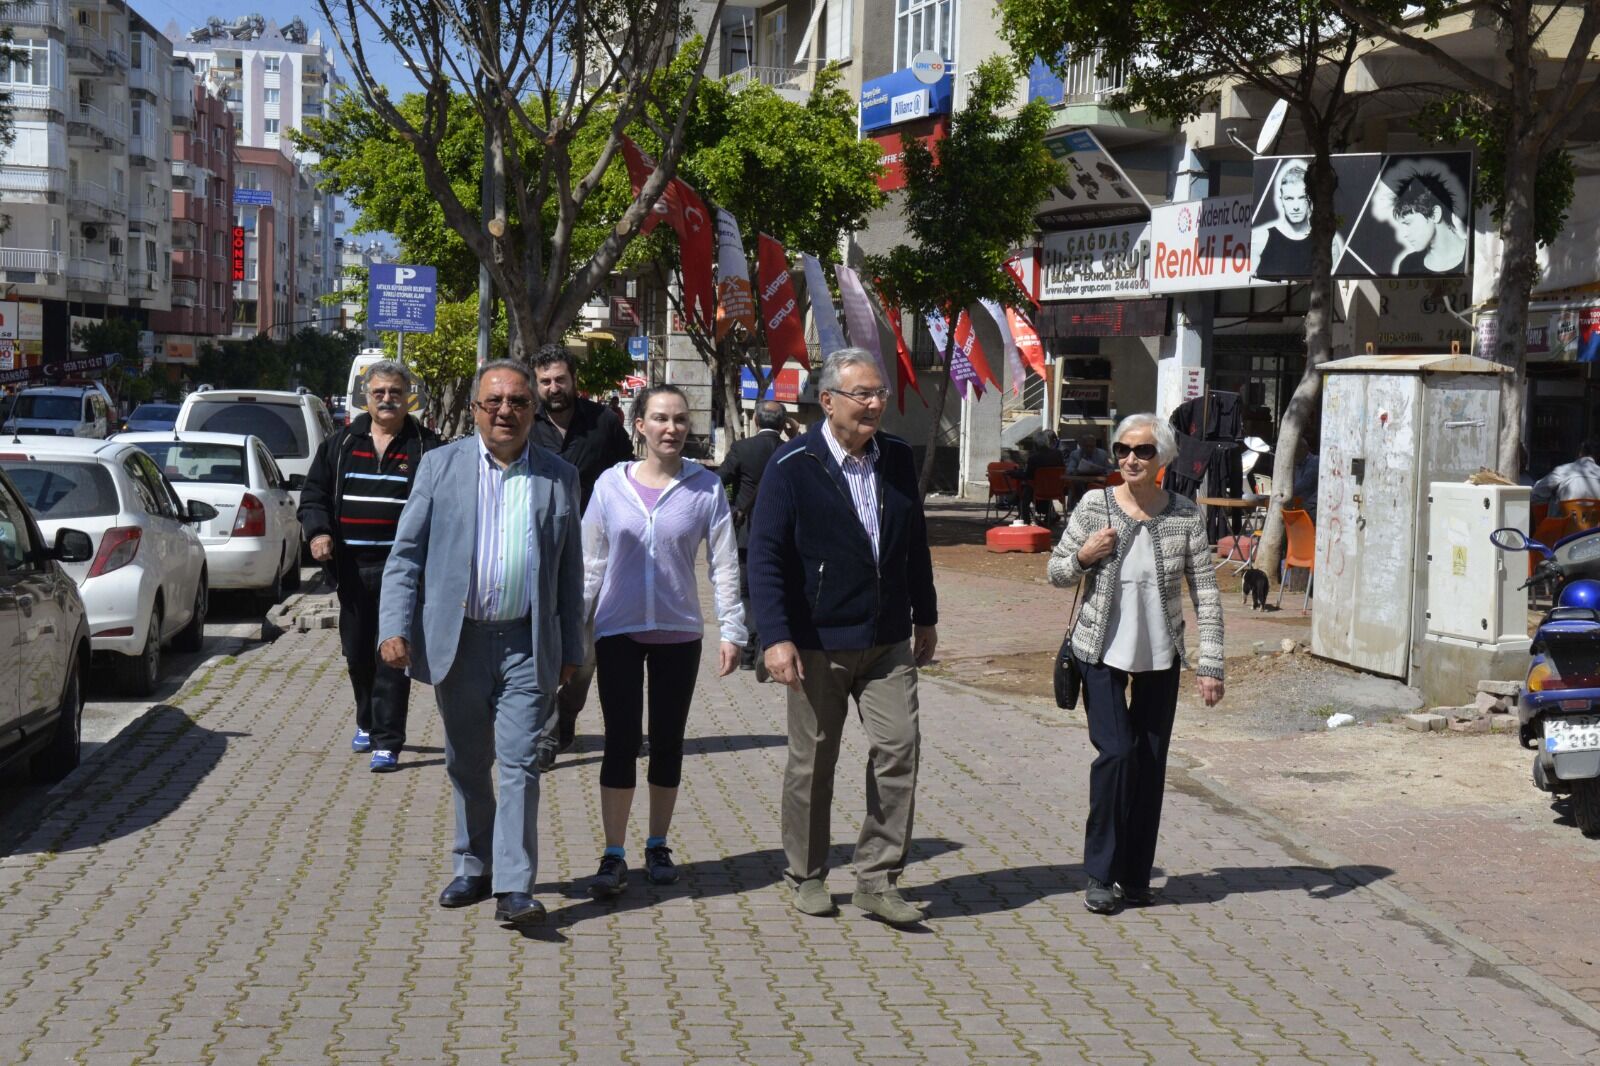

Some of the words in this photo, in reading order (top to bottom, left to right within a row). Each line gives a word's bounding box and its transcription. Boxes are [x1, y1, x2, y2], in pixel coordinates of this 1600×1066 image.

[894, 100, 913, 117] Allianz
[1196, 203, 1230, 229] Akdeniz
[1101, 240, 1150, 280] GRUP
[1154, 235, 1217, 279] Renkli
[395, 267, 417, 285] P
[768, 298, 795, 329] GRUP
